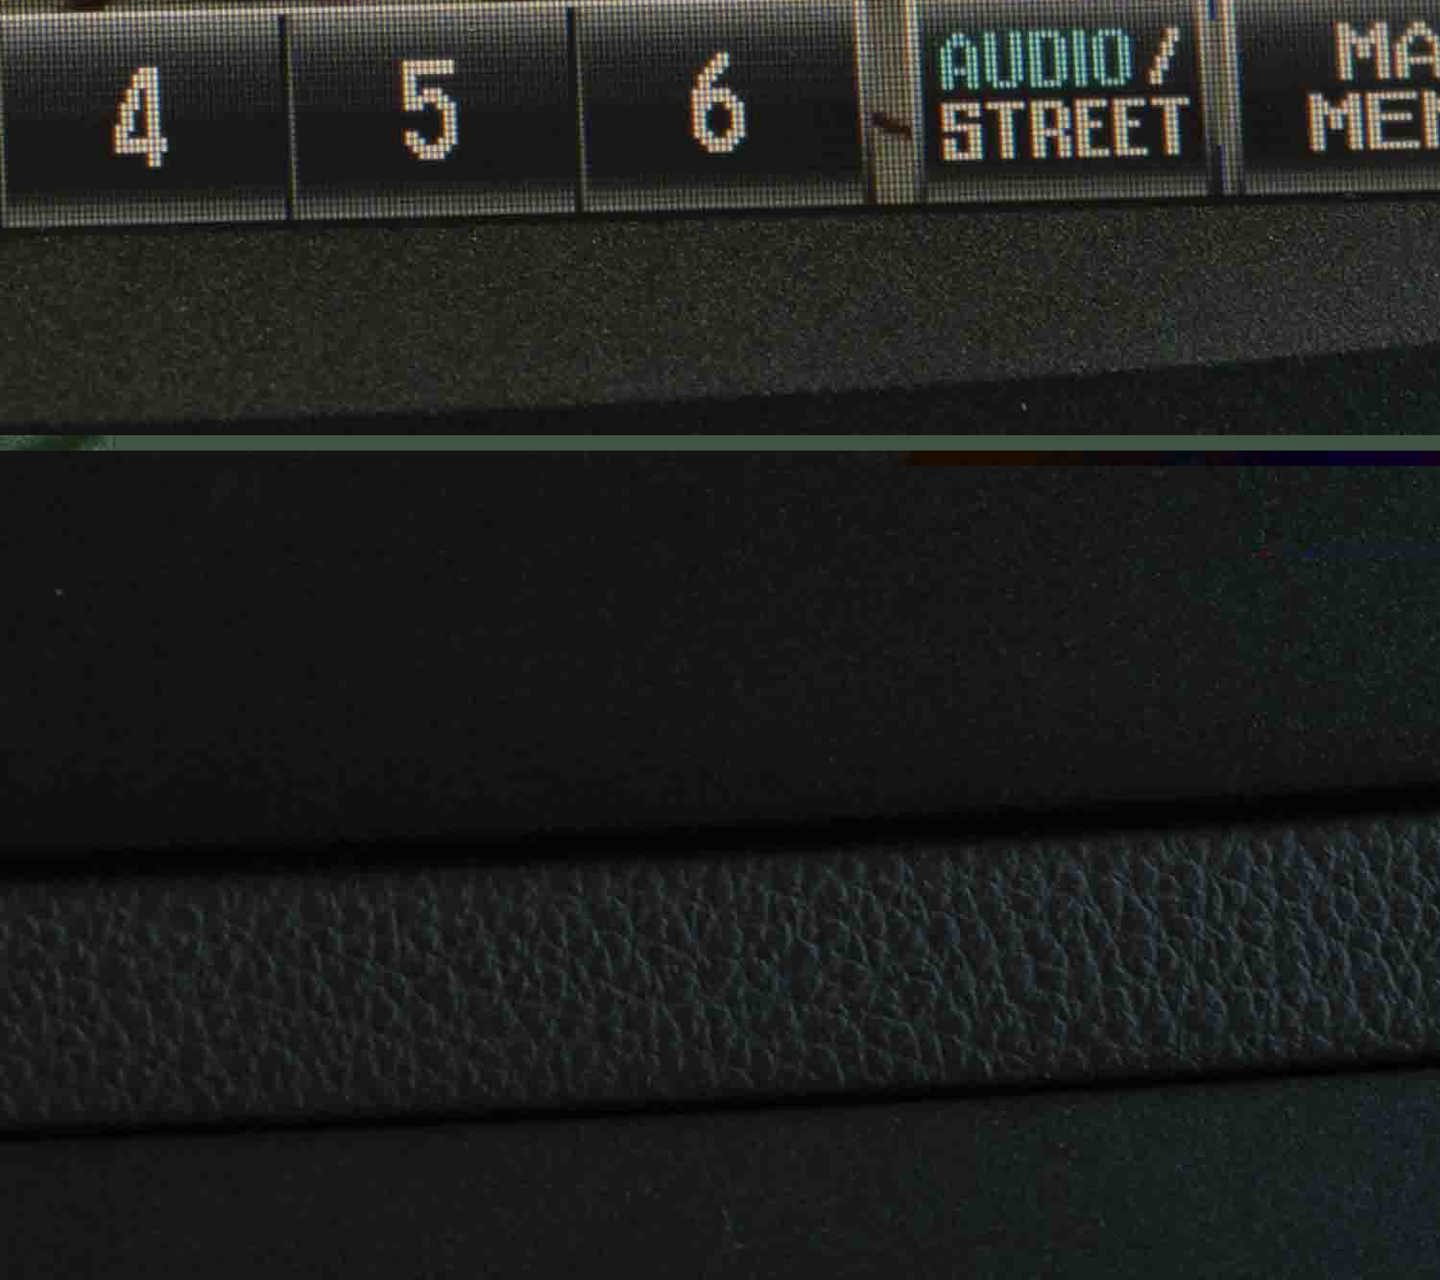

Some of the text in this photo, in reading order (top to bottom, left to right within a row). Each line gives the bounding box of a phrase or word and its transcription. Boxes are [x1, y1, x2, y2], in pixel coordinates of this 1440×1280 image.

[112, 65, 169, 169] 4
[399, 58, 459, 161] 5
[689, 51, 746, 154] 6
[938, 95, 1191, 163] STREET
